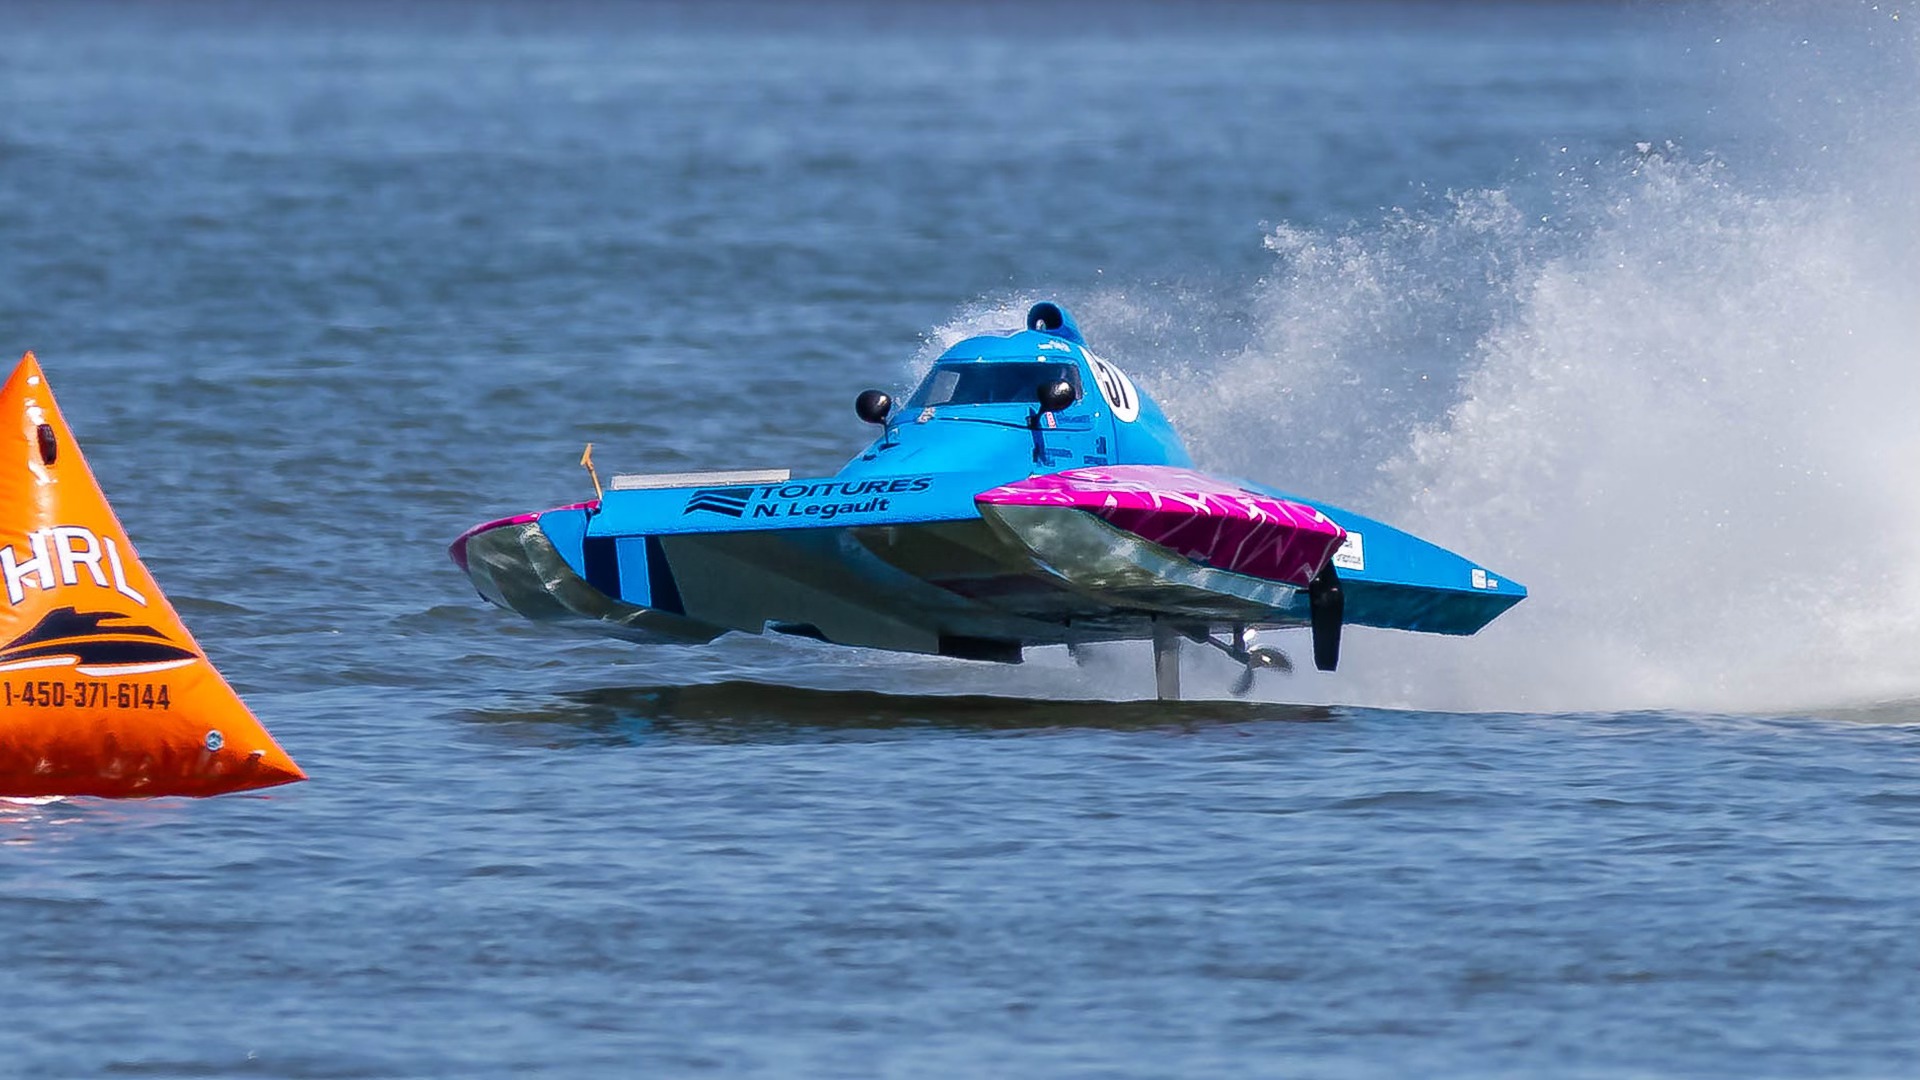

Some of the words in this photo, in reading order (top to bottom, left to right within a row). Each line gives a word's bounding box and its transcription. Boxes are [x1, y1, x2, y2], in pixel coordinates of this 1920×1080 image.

[760, 477, 933, 500] TOITURES
[752, 503, 780, 518] N.
[788, 498, 891, 519] Legault
[0, 526, 147, 607] HRL
[4, 682, 170, 710] 1-450-371-6144
